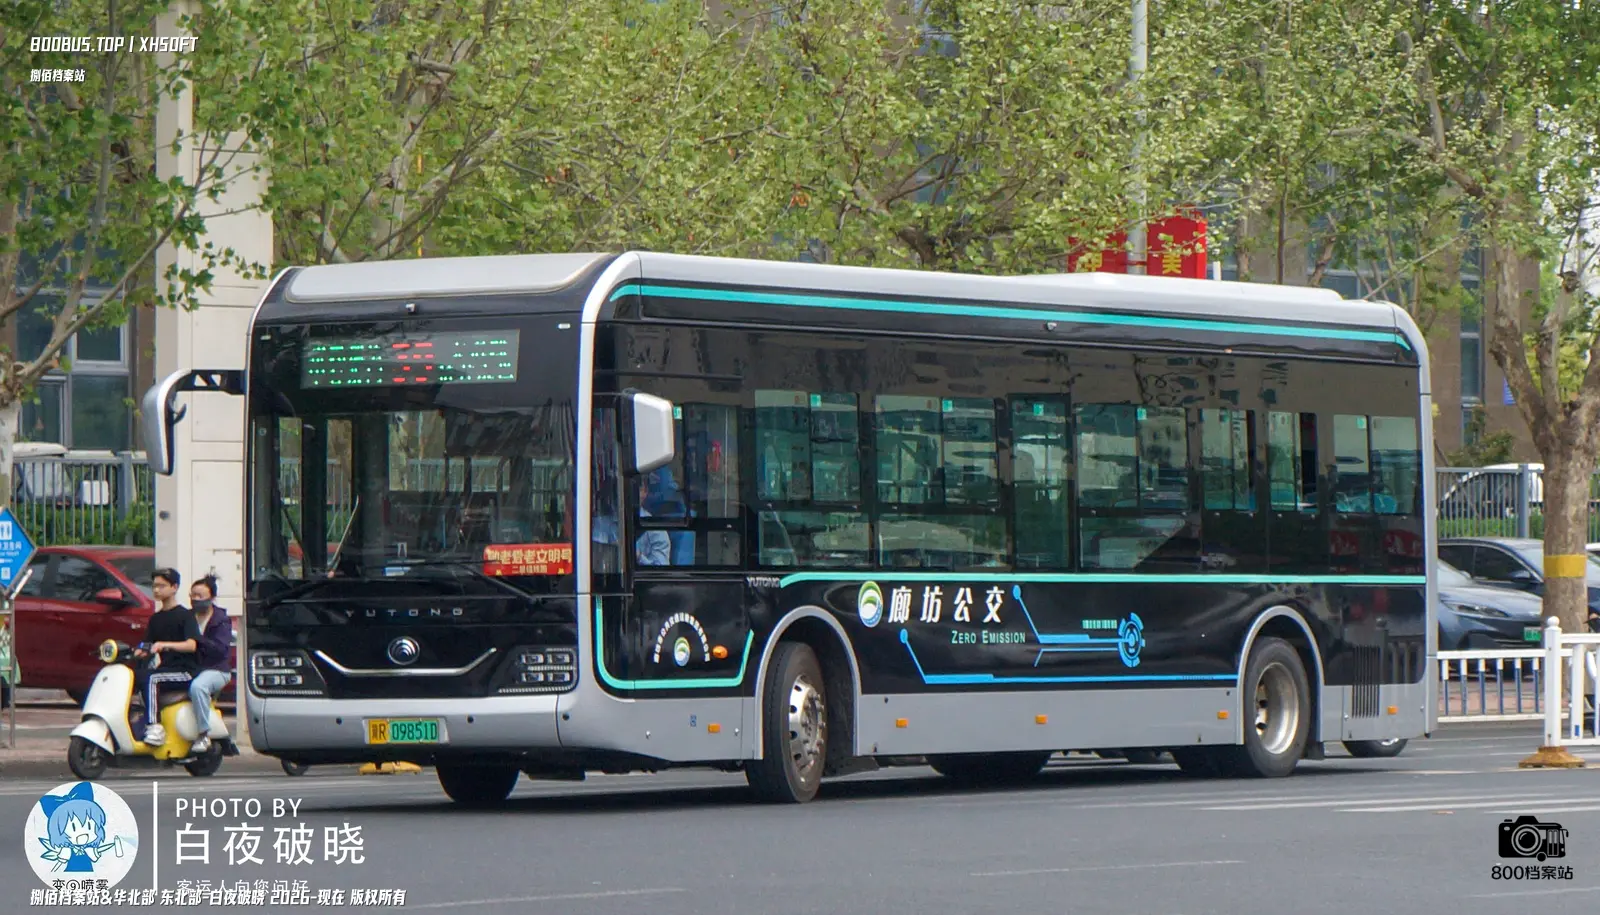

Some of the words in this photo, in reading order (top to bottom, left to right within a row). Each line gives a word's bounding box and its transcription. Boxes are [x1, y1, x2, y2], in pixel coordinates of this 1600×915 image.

[345, 607, 463, 618] YUTONG
[887, 585, 1006, 624] 廊坊公交
